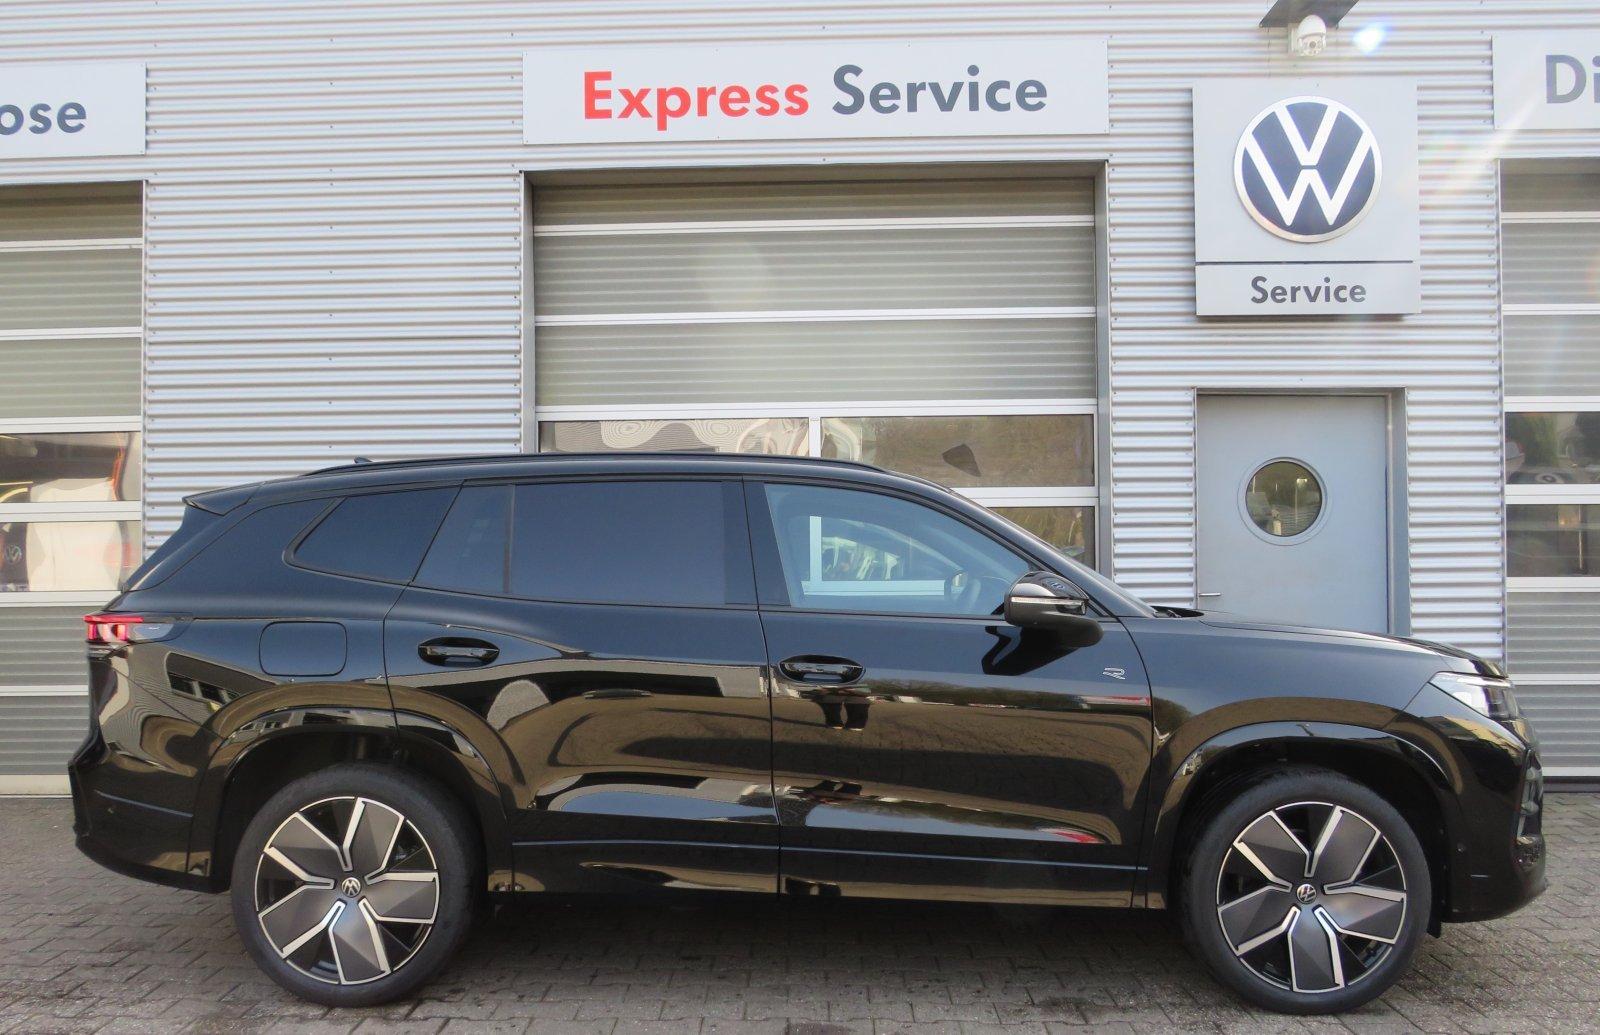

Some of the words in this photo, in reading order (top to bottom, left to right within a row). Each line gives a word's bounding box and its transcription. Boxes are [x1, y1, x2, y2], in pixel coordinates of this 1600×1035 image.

[0, 102, 87, 136] ose
[584, 71, 809, 131] Express
[832, 64, 1047, 115] Service
[1236, 97, 1380, 237] VW
[1250, 275, 1366, 304] Service
